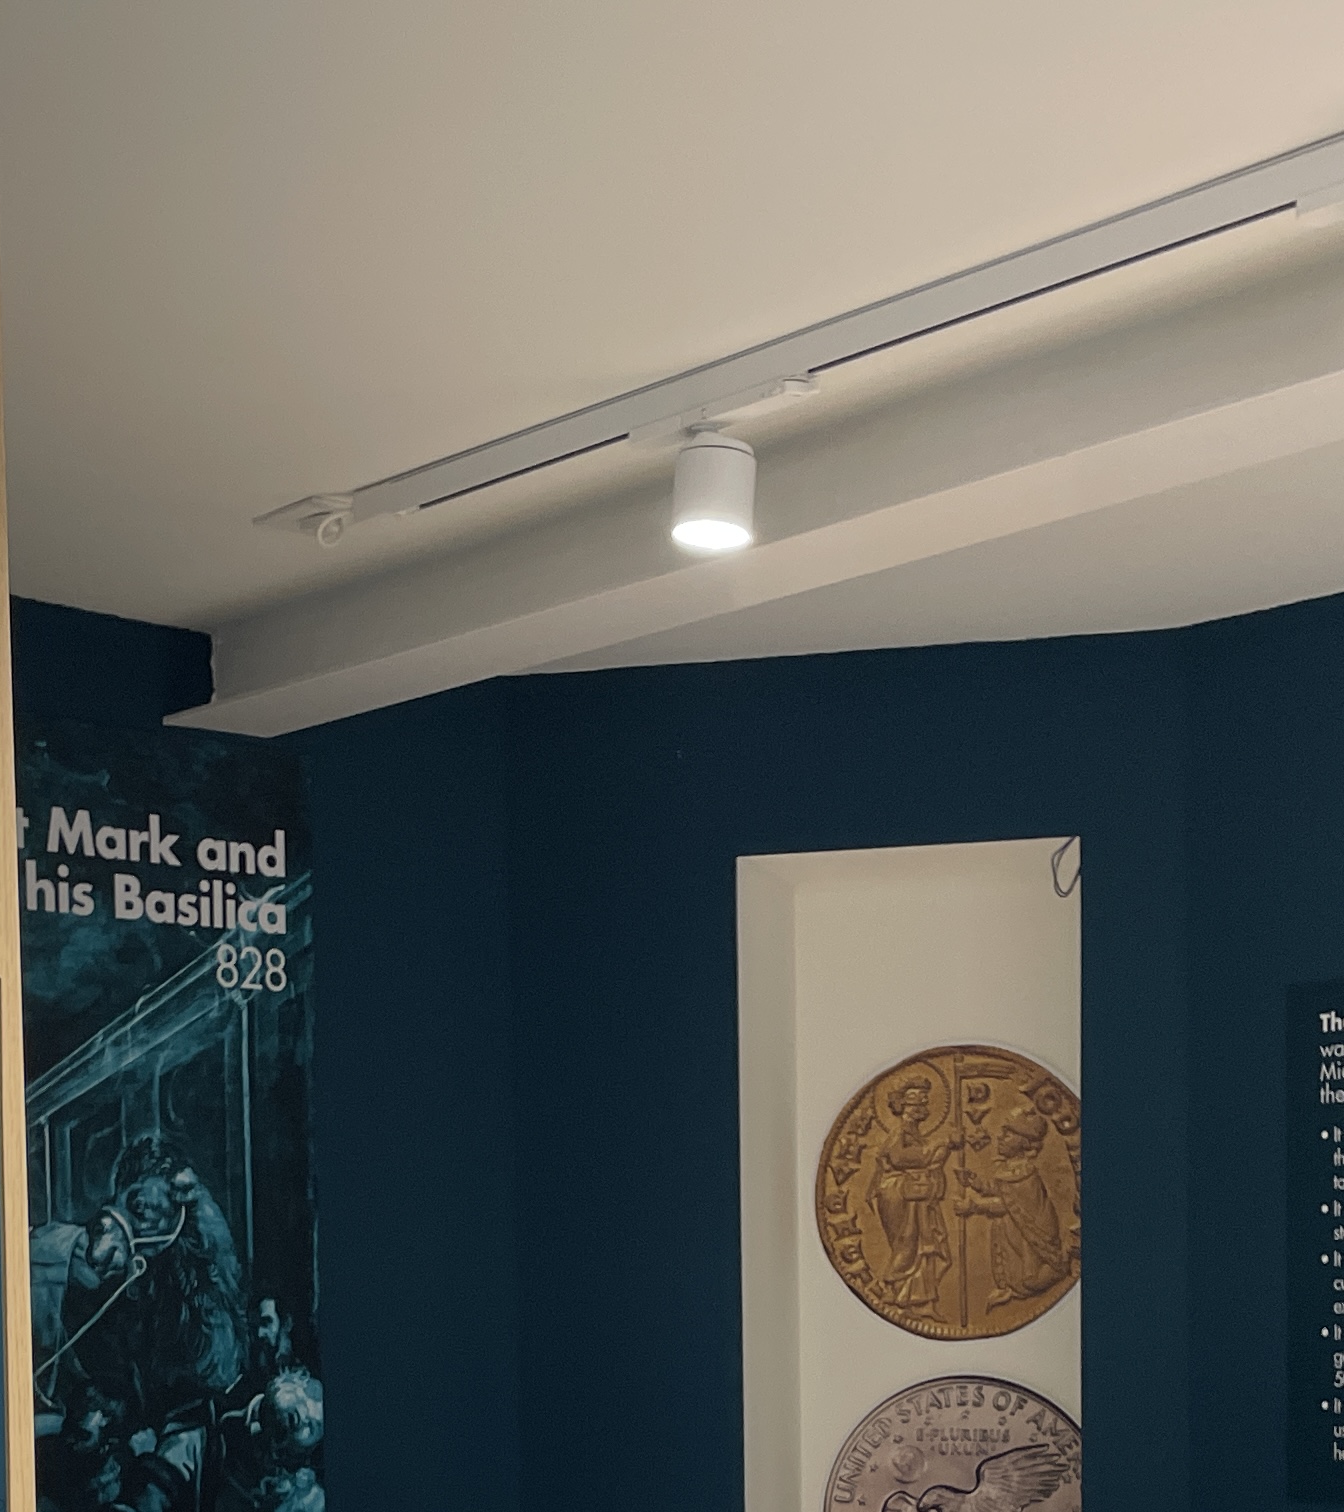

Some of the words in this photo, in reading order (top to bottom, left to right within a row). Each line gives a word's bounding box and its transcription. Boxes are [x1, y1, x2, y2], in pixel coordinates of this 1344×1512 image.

[46, 805, 182, 867] Mark
[197, 829, 287, 877] and
[25, 859, 95, 917] his
[114, 873, 287, 935] Basilica
[216, 944, 287, 993] 828
[1320, 1082, 1344, 1104] the
[1334, 1126, 1341, 1142] It
[1334, 1200, 1342, 1217] It
[1334, 1398, 1341, 1413] It
[834, 1417, 893, 1505] UNITED
[895, 1385, 985, 1424] STATES
[992, 1390, 1029, 1416] OF
